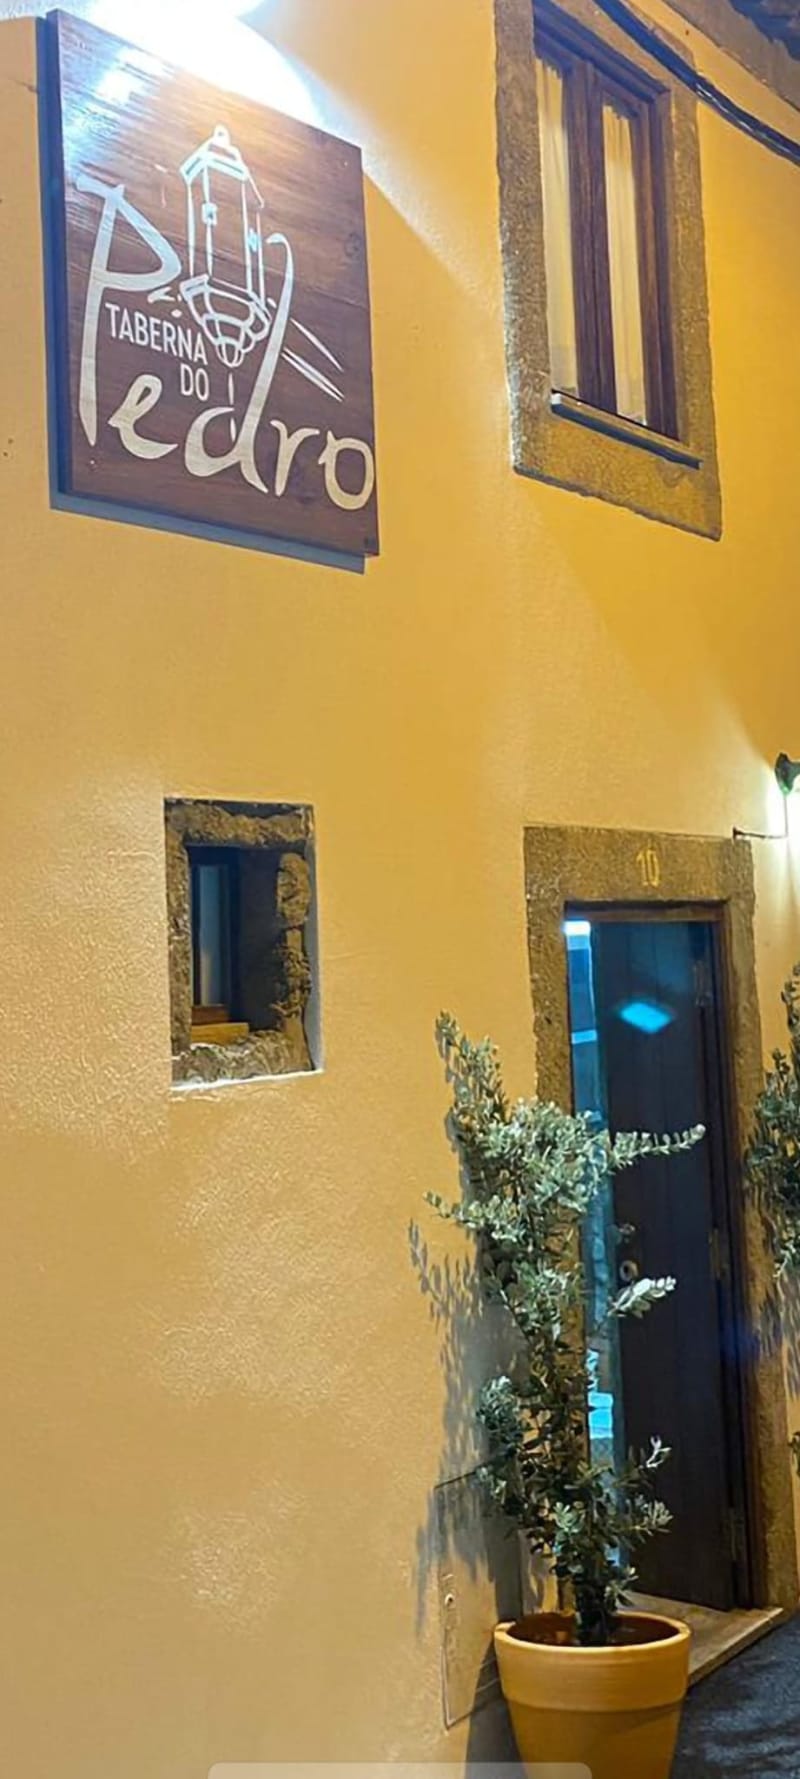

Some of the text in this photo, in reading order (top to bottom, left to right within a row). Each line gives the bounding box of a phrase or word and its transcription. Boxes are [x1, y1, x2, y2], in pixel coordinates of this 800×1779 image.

[76, 176, 375, 510] Pedro
[105, 303, 208, 365] TABERNA
[180, 365, 209, 401] DO
[636, 849, 660, 887] 10
